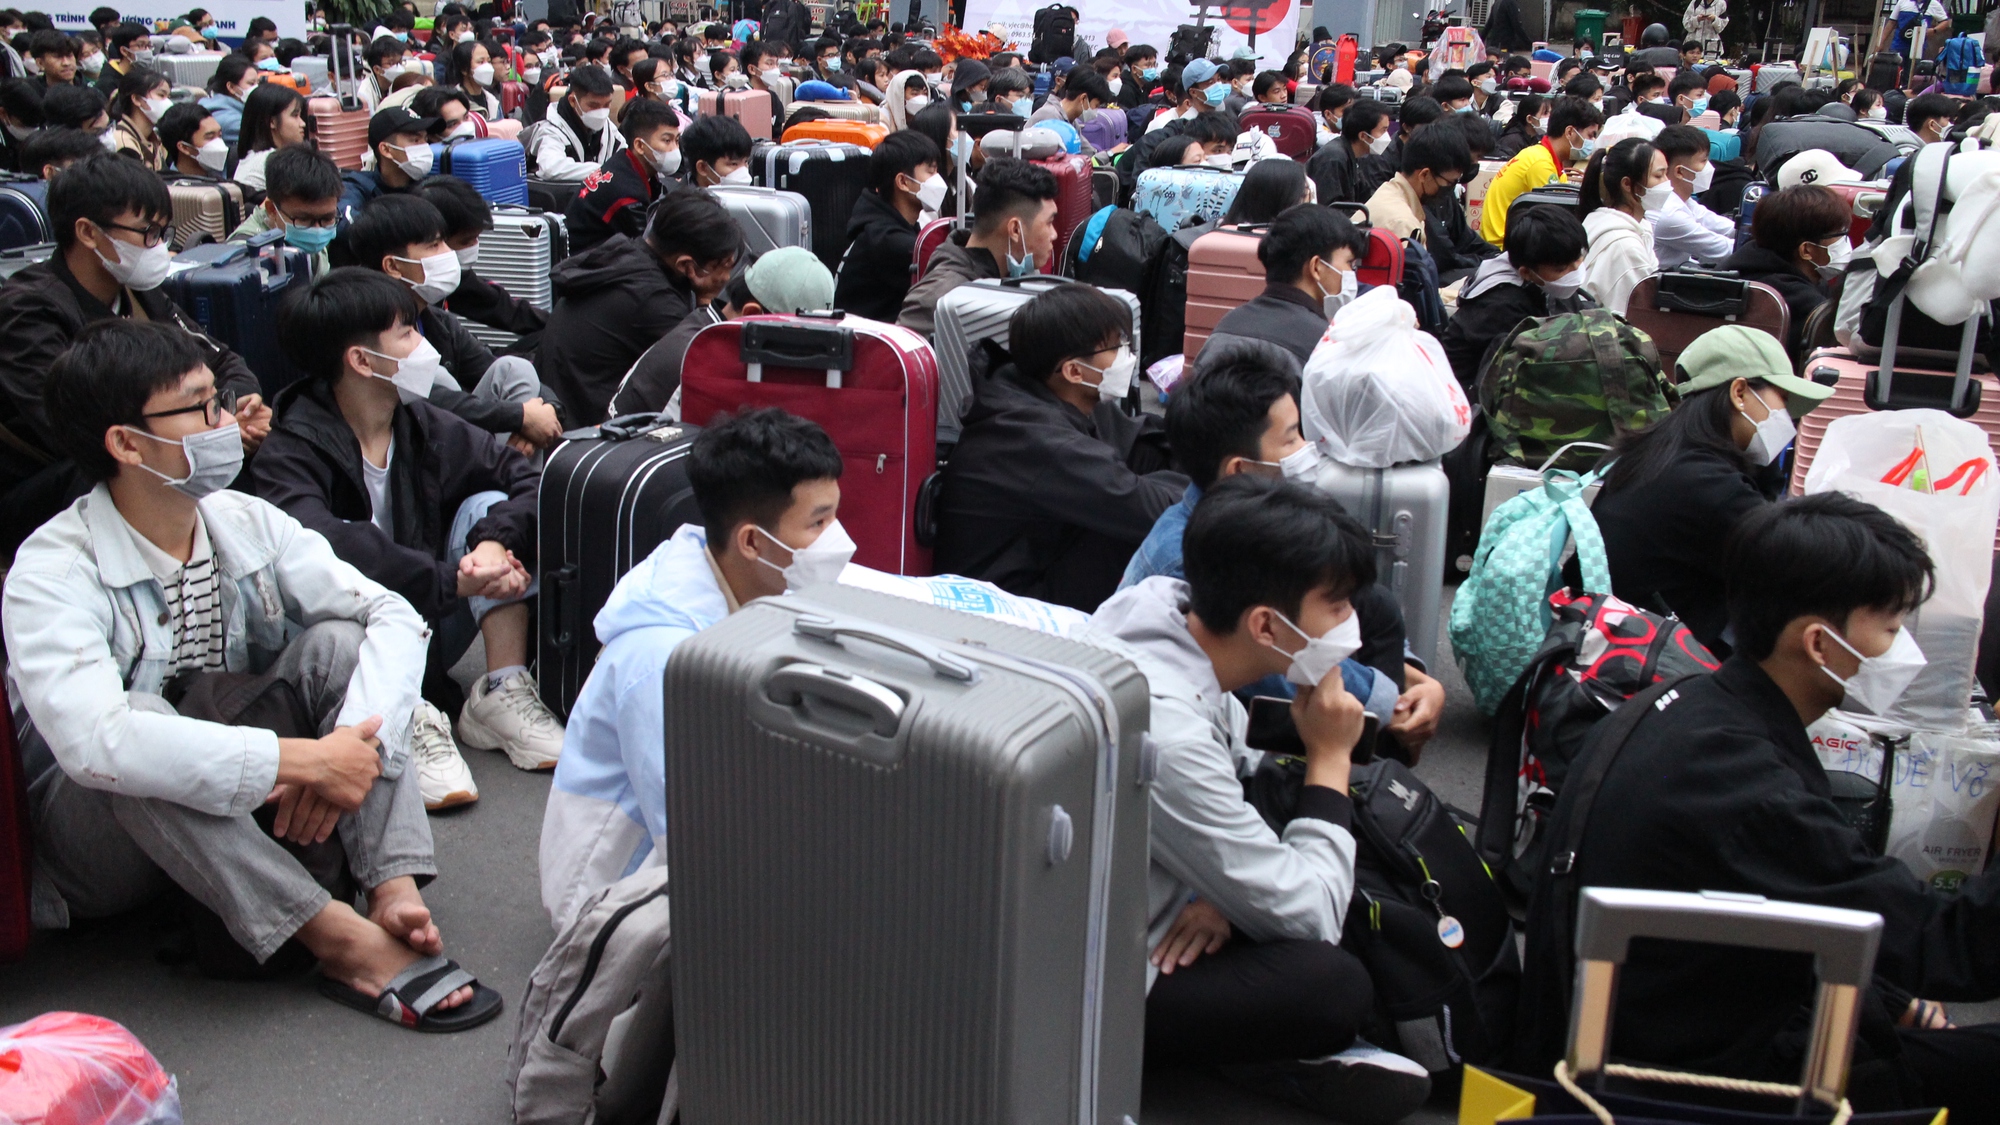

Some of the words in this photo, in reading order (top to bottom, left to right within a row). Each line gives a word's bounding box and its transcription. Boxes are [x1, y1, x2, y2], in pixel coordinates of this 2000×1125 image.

[55, 12, 85, 23] TRÌNH
[1811, 734, 1859, 751] AGIC
[1922, 845, 1943, 854] AIR
[1947, 847, 1981, 857] FRYER
